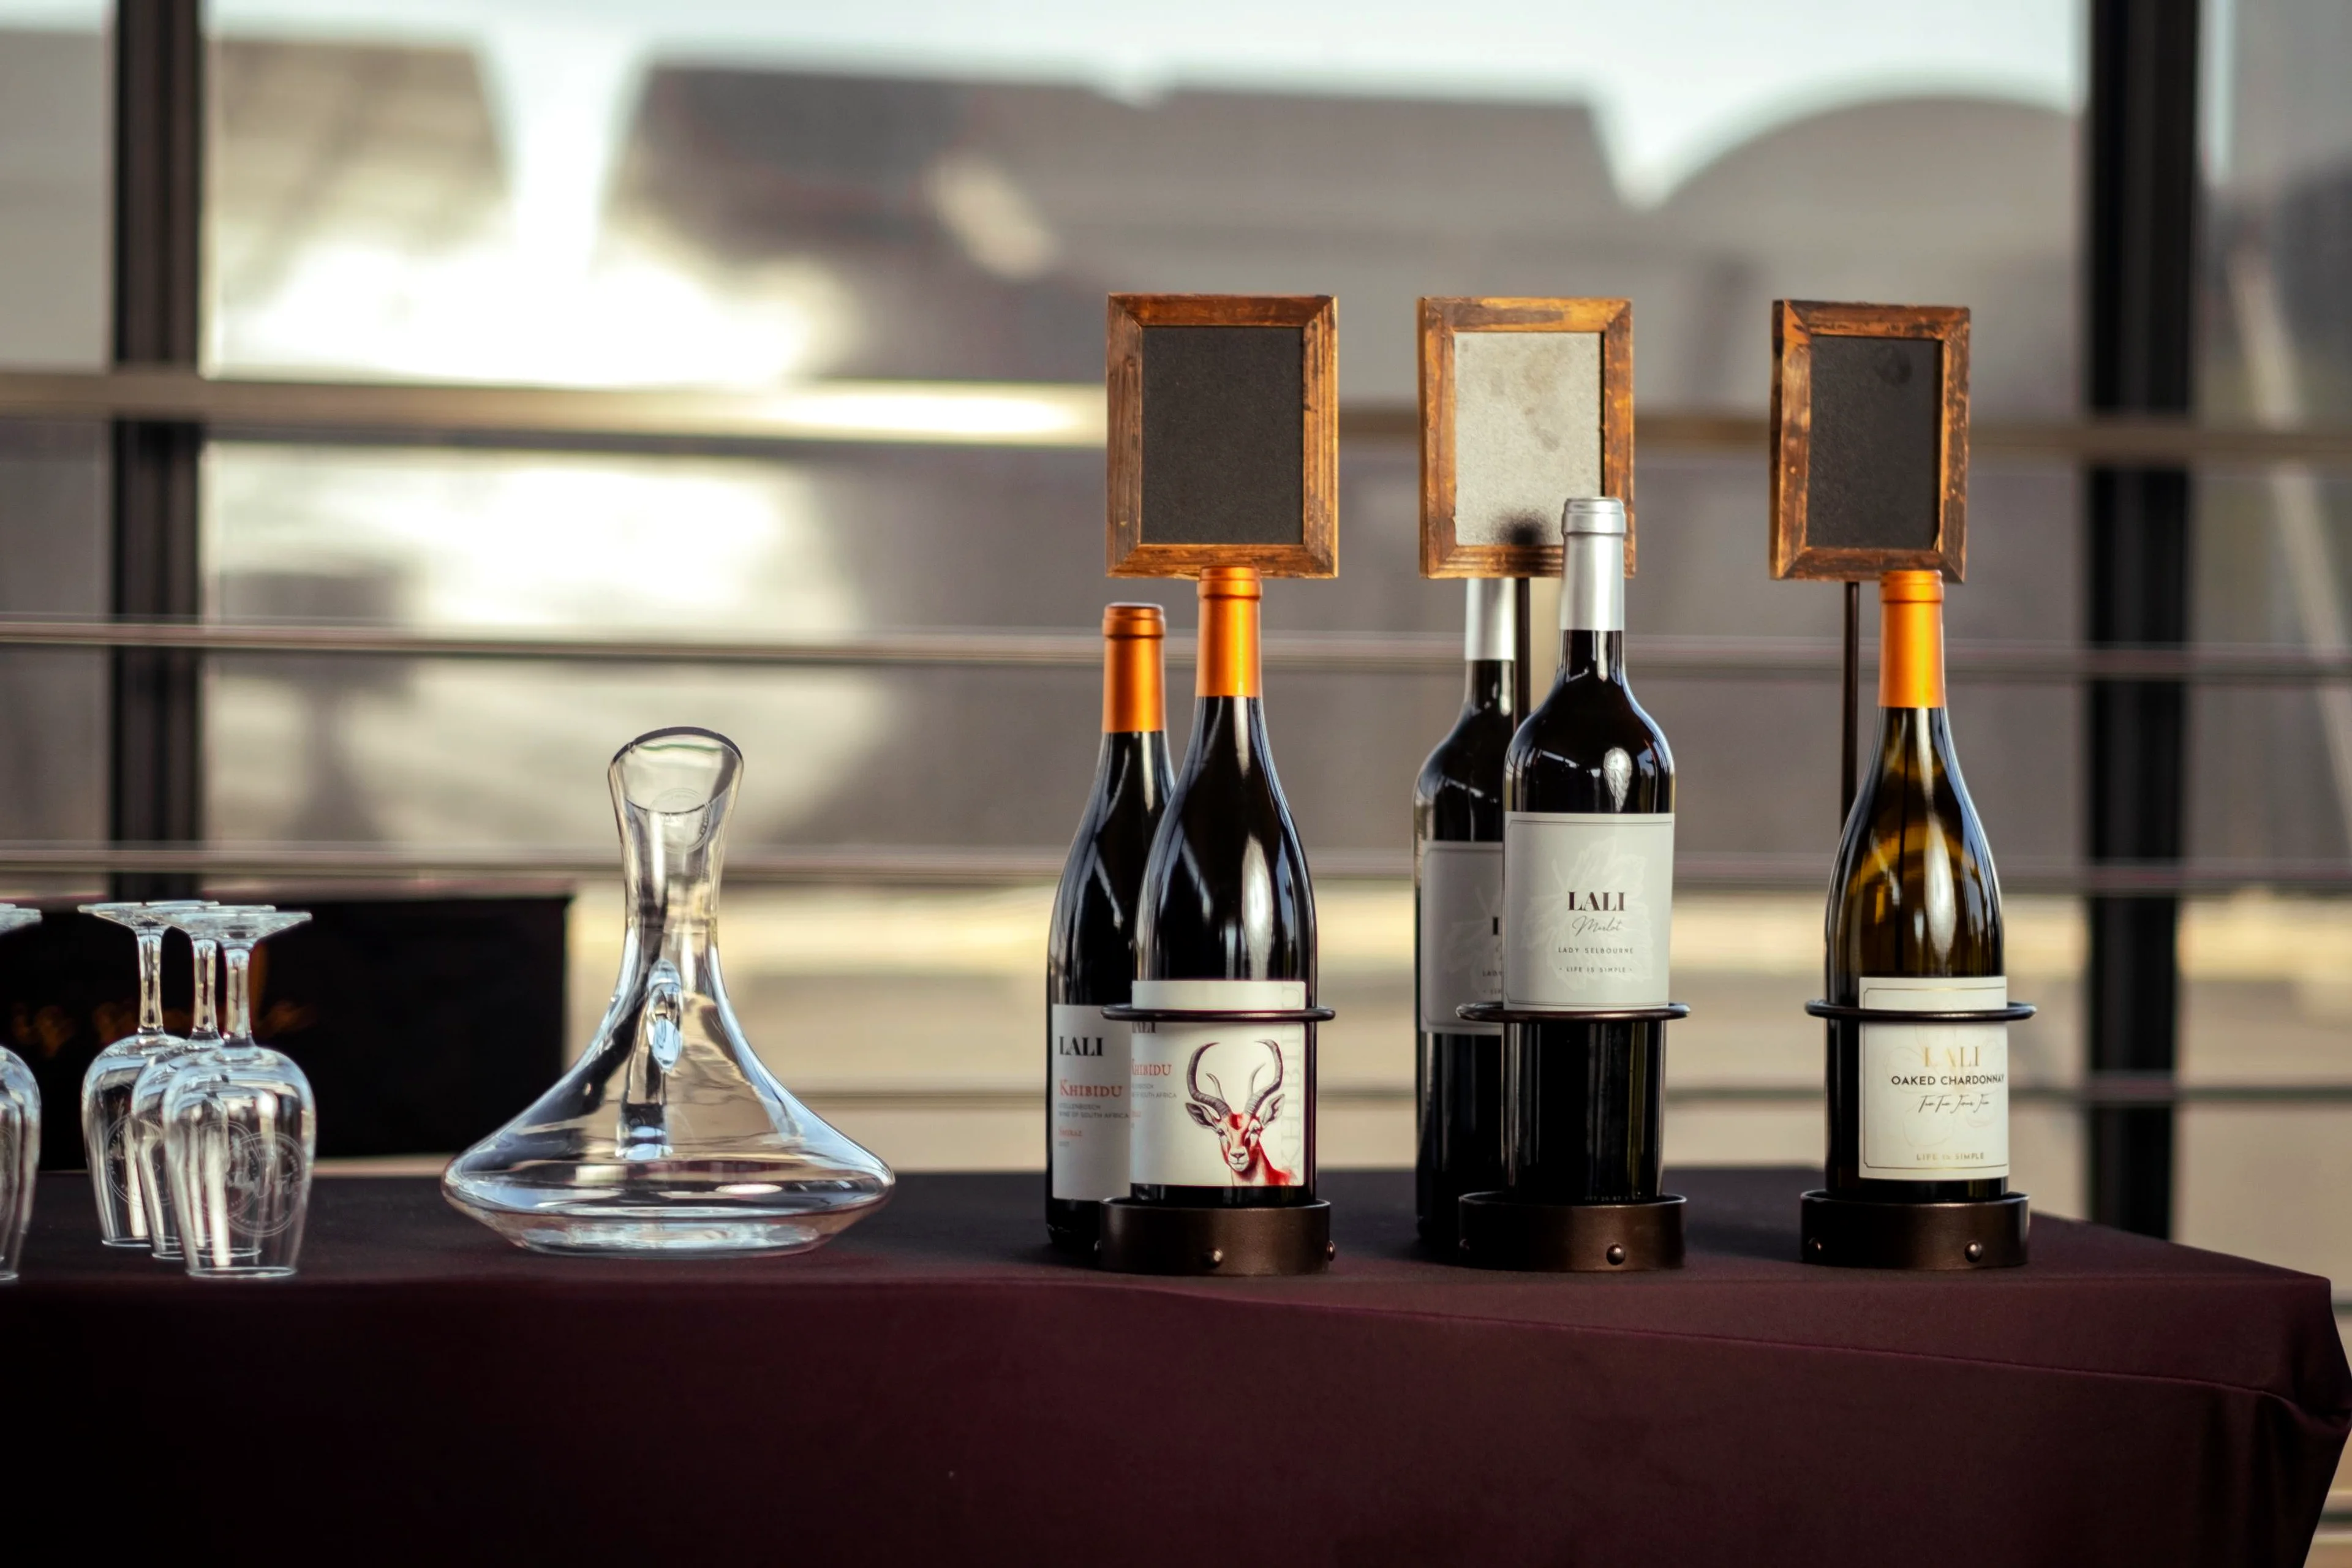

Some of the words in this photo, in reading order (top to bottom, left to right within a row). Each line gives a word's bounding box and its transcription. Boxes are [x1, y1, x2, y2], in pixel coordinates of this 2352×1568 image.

[1568, 891, 1624, 911] LALI
[1572, 915, 1622, 937] Merlot
[1059, 1035, 1104, 1057] LALI
[1924, 1046, 1980, 1068] LALI
[1060, 1079, 1123, 1097] KHIBIDU
[1891, 1076, 1936, 1085] OAKED
[1940, 1074, 2005, 1085] CHARDONNAY
[1954, 1152, 1984, 1160] SIMPLE
